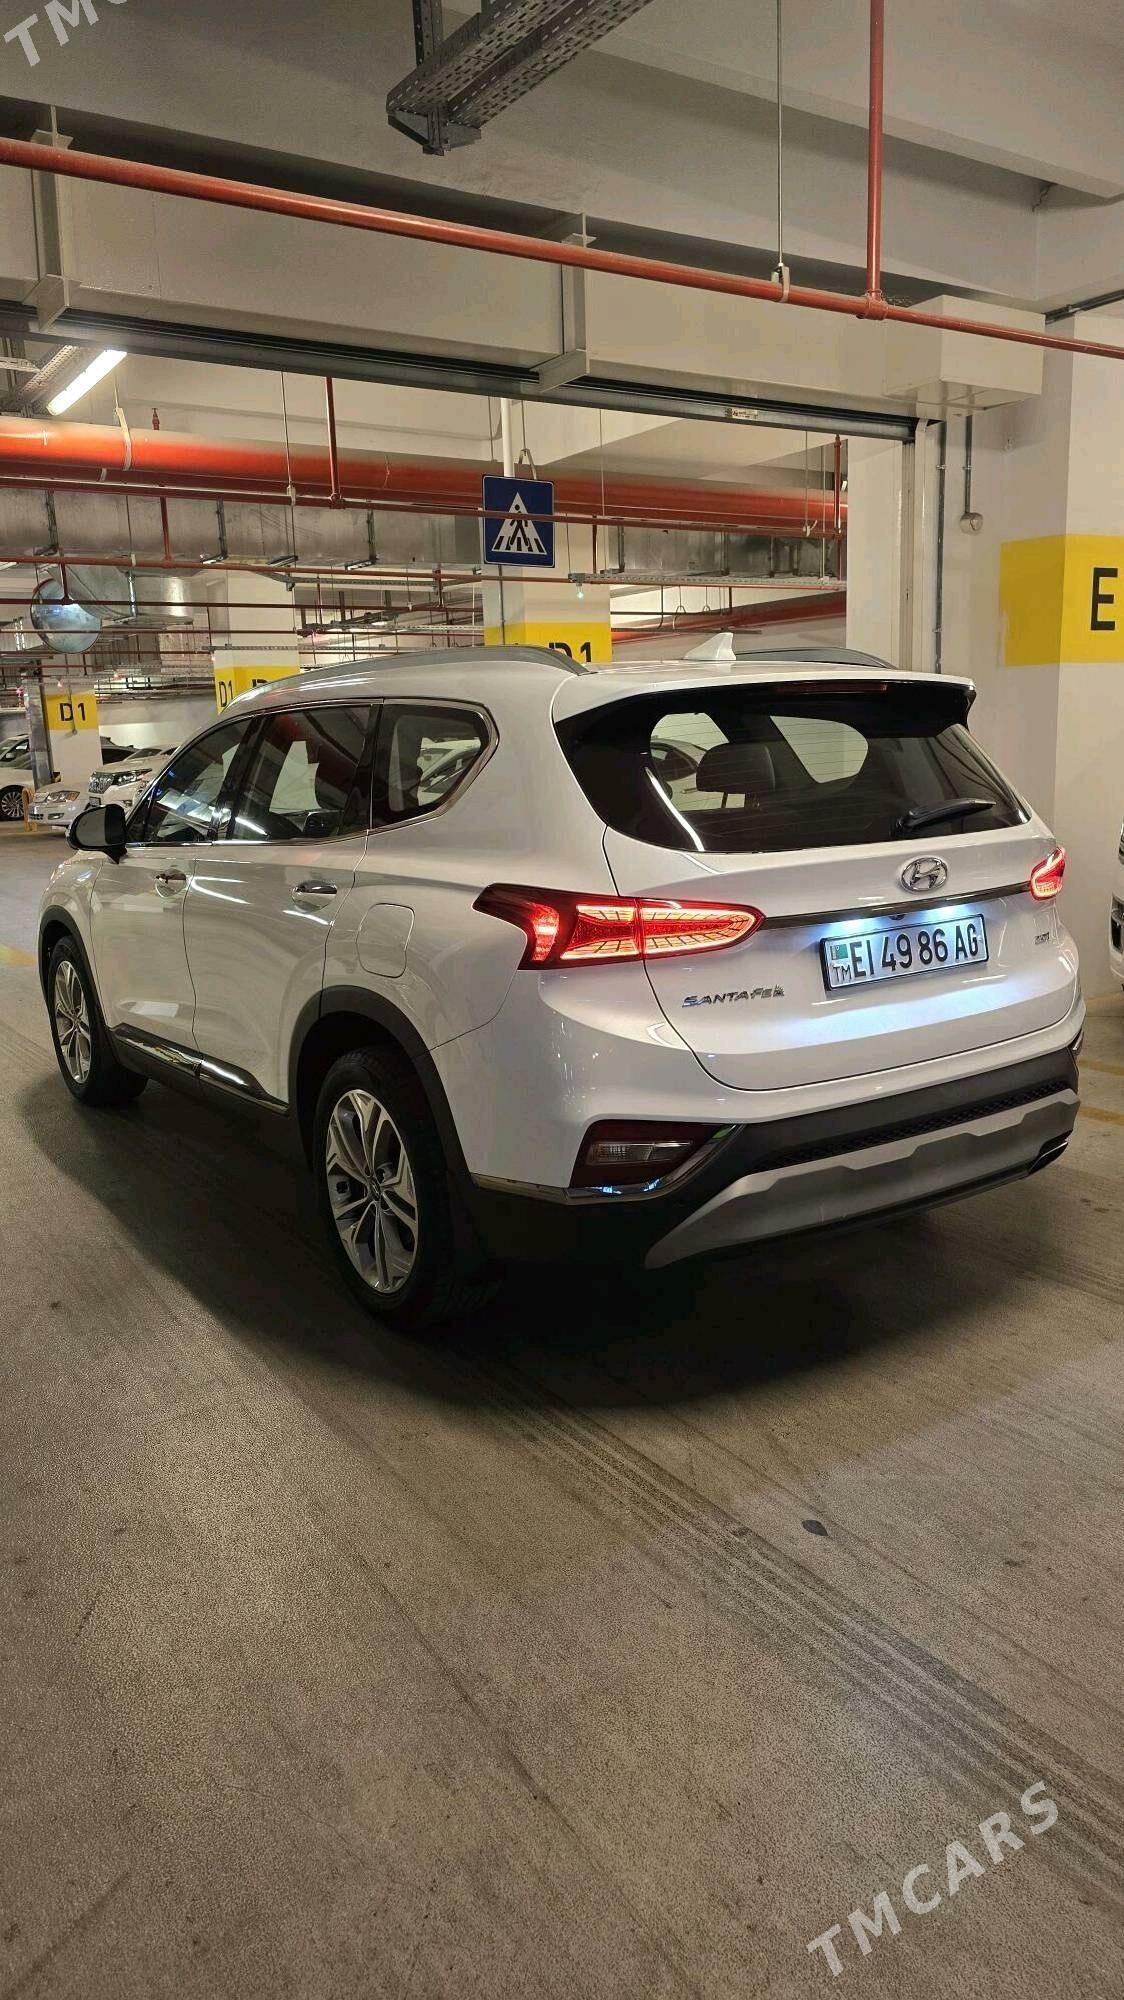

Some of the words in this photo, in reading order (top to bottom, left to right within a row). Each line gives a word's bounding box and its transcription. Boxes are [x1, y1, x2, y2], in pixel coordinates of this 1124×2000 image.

[1090, 567, 1119, 631] E
[219, 680, 233, 707] D1
[60, 702, 86, 721] D1
